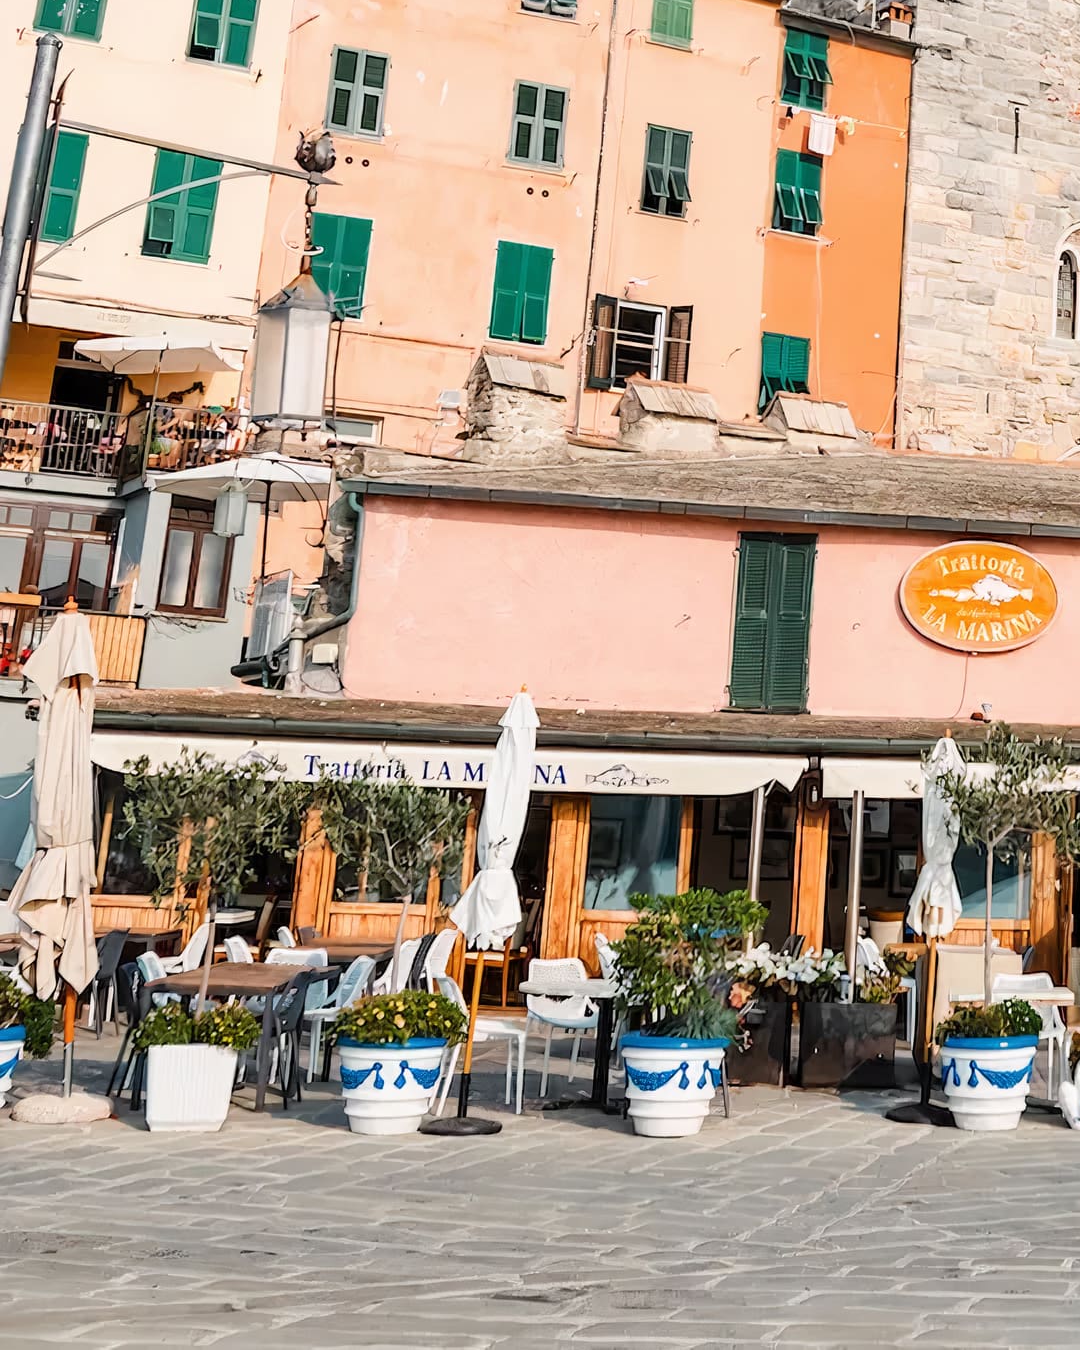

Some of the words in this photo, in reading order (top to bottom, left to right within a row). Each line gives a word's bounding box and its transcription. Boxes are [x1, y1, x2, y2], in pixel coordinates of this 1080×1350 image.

[935, 554, 1025, 581] Trattoria
[921, 604, 948, 633] LA
[956, 609, 1043, 642] MARINA
[422, 760, 452, 781] LA
[463, 762, 567, 785] MNA
